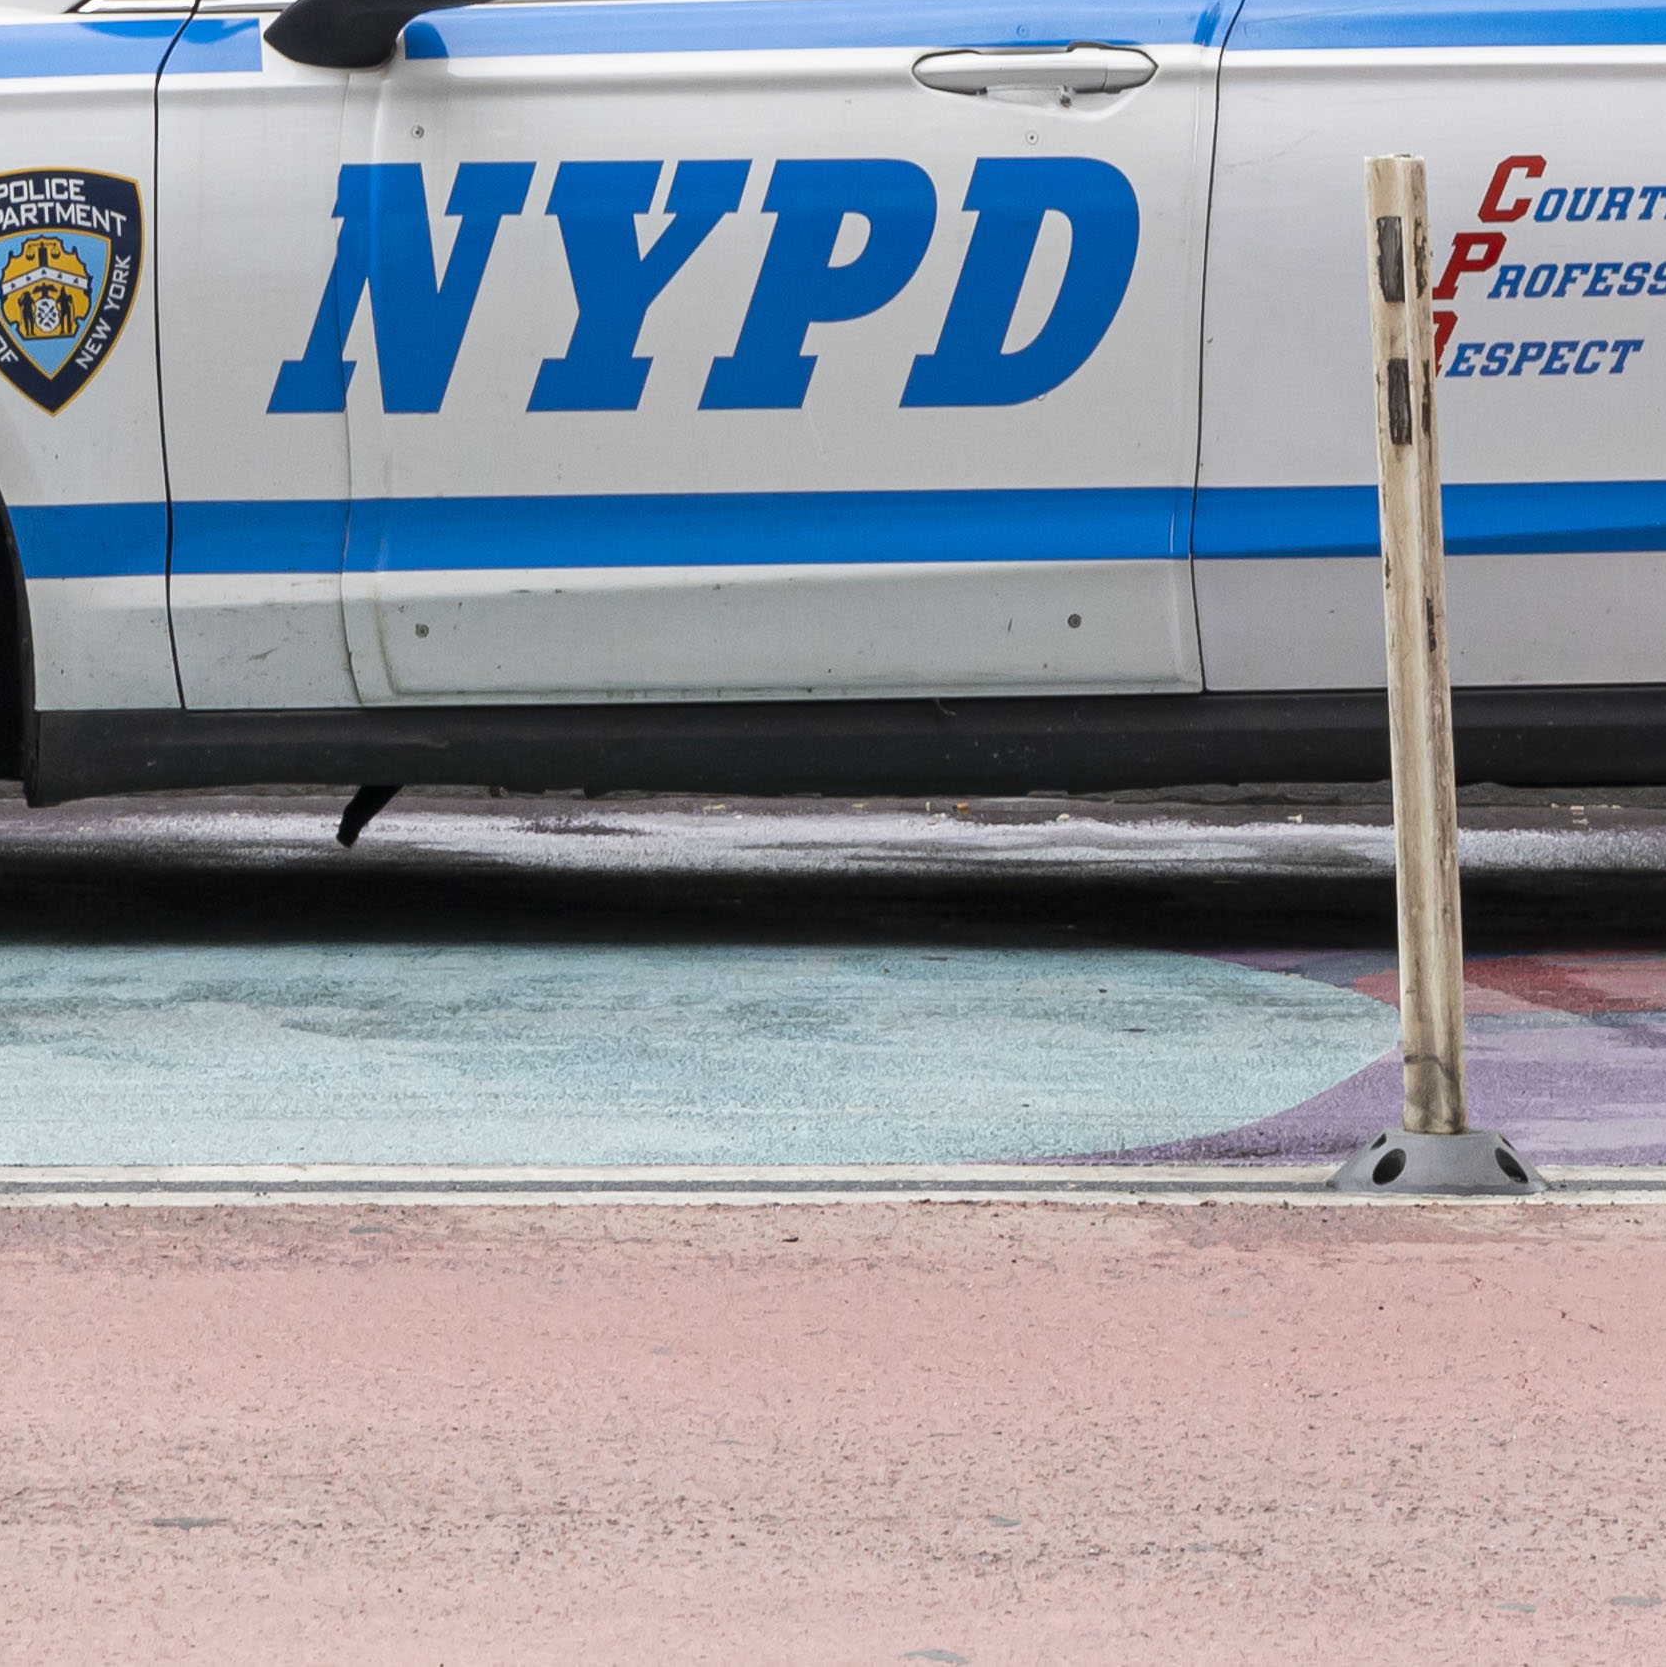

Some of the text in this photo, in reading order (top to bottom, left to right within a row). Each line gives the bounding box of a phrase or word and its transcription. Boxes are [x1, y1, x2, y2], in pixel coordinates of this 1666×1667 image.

[75, 254, 132, 370] NEW YORK
[266, 157, 1140, 414] NYPD
